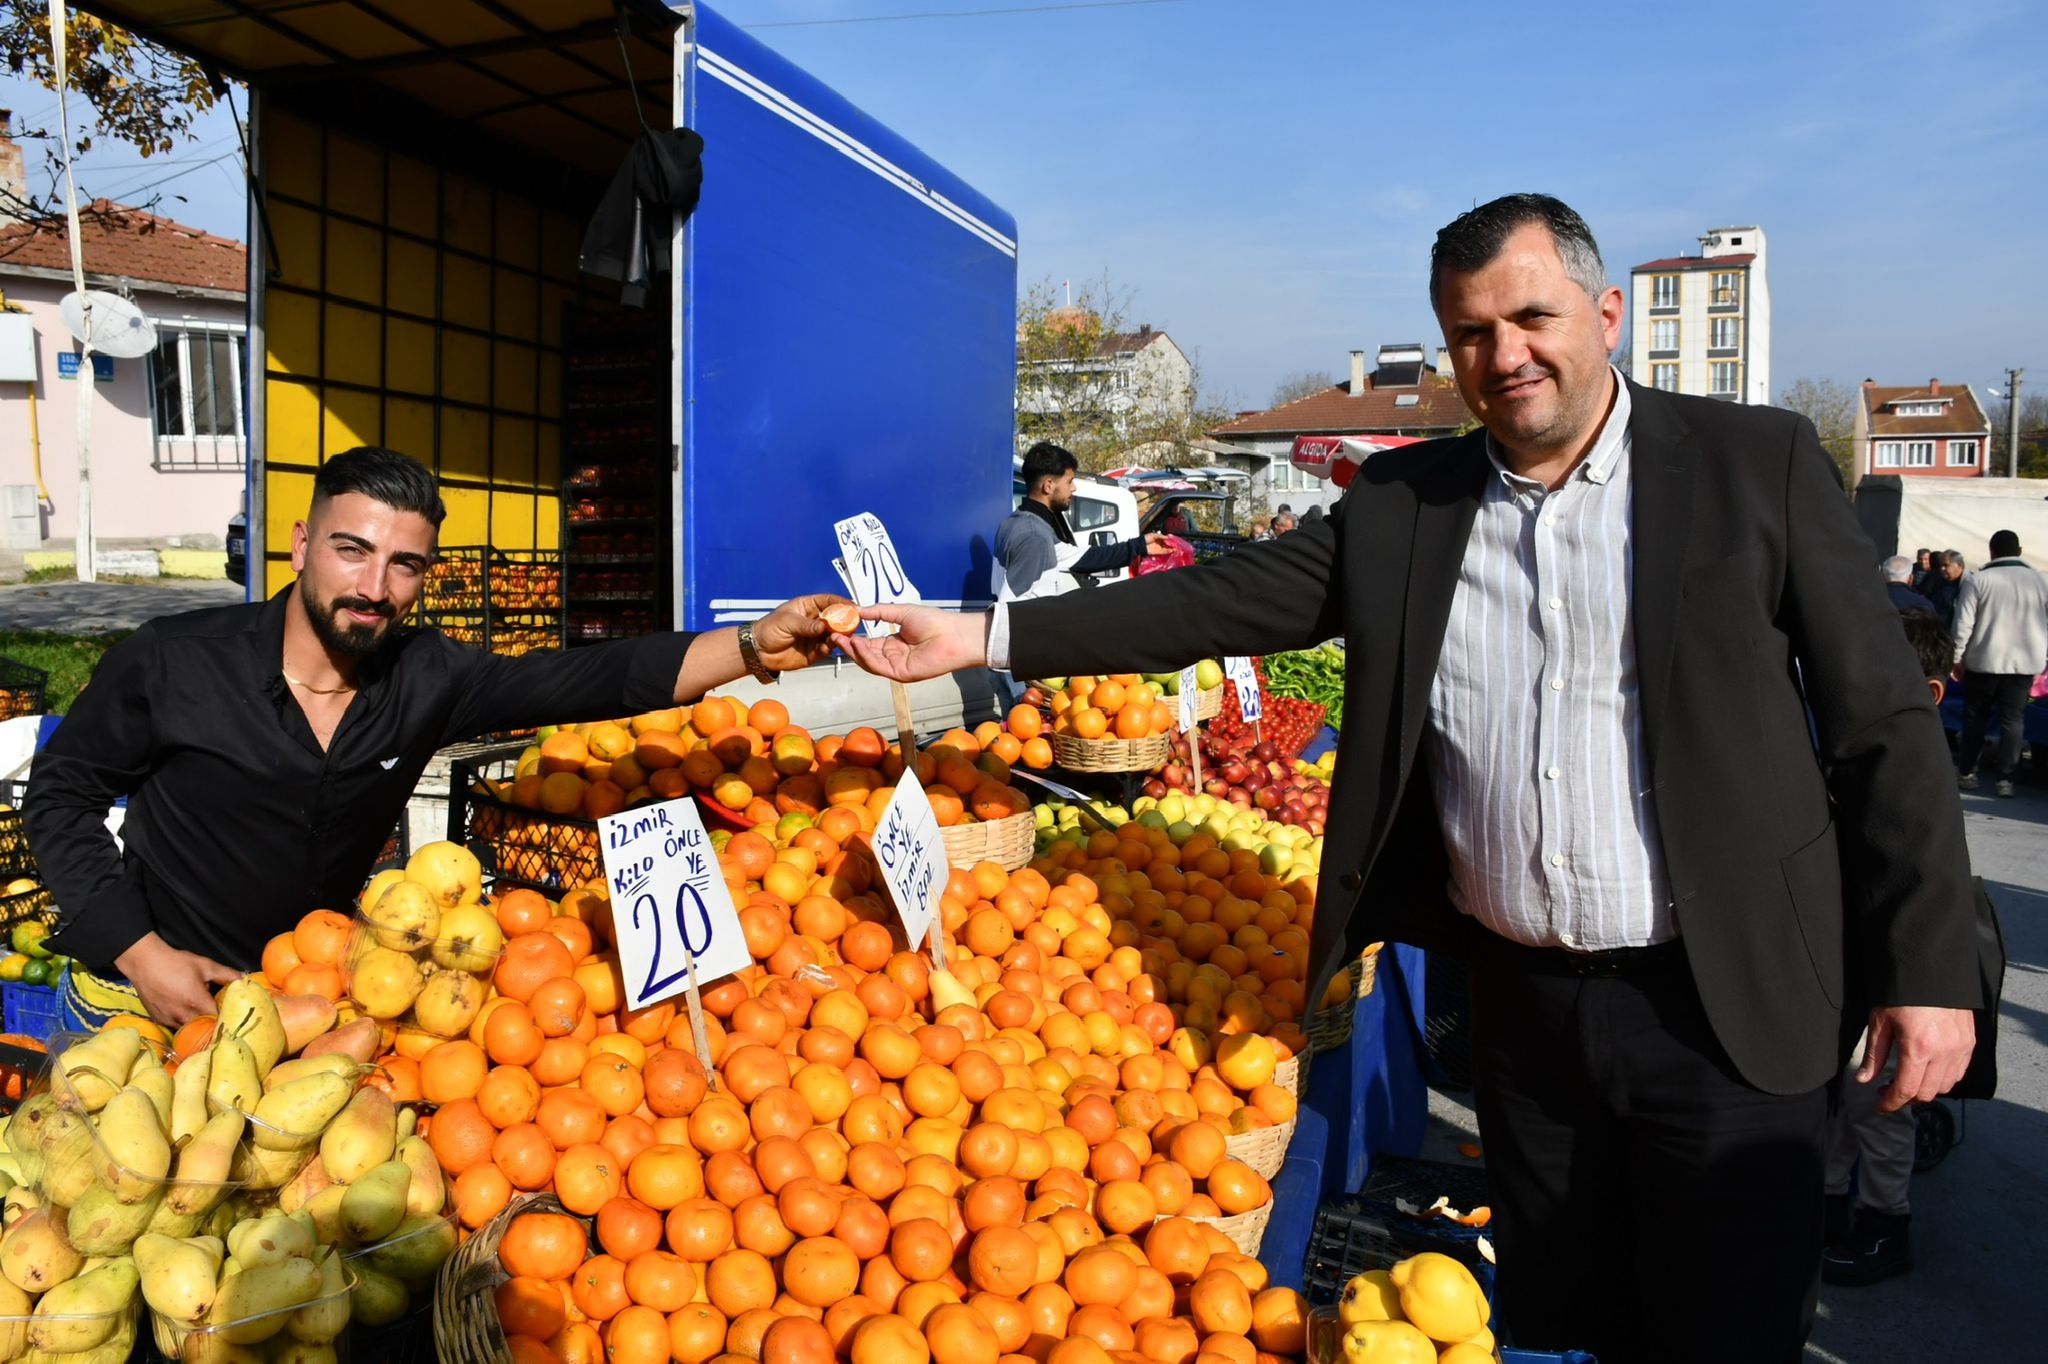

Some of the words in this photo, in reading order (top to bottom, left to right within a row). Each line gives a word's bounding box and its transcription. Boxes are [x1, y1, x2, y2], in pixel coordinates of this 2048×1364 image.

[663, 828, 703, 858] ÖNCE
[877, 800, 904, 869] ÖNCE
[898, 823, 914, 853] YE
[614, 855, 654, 895] KİLO
[686, 851, 708, 874] YE
[632, 882, 714, 1003] 20
